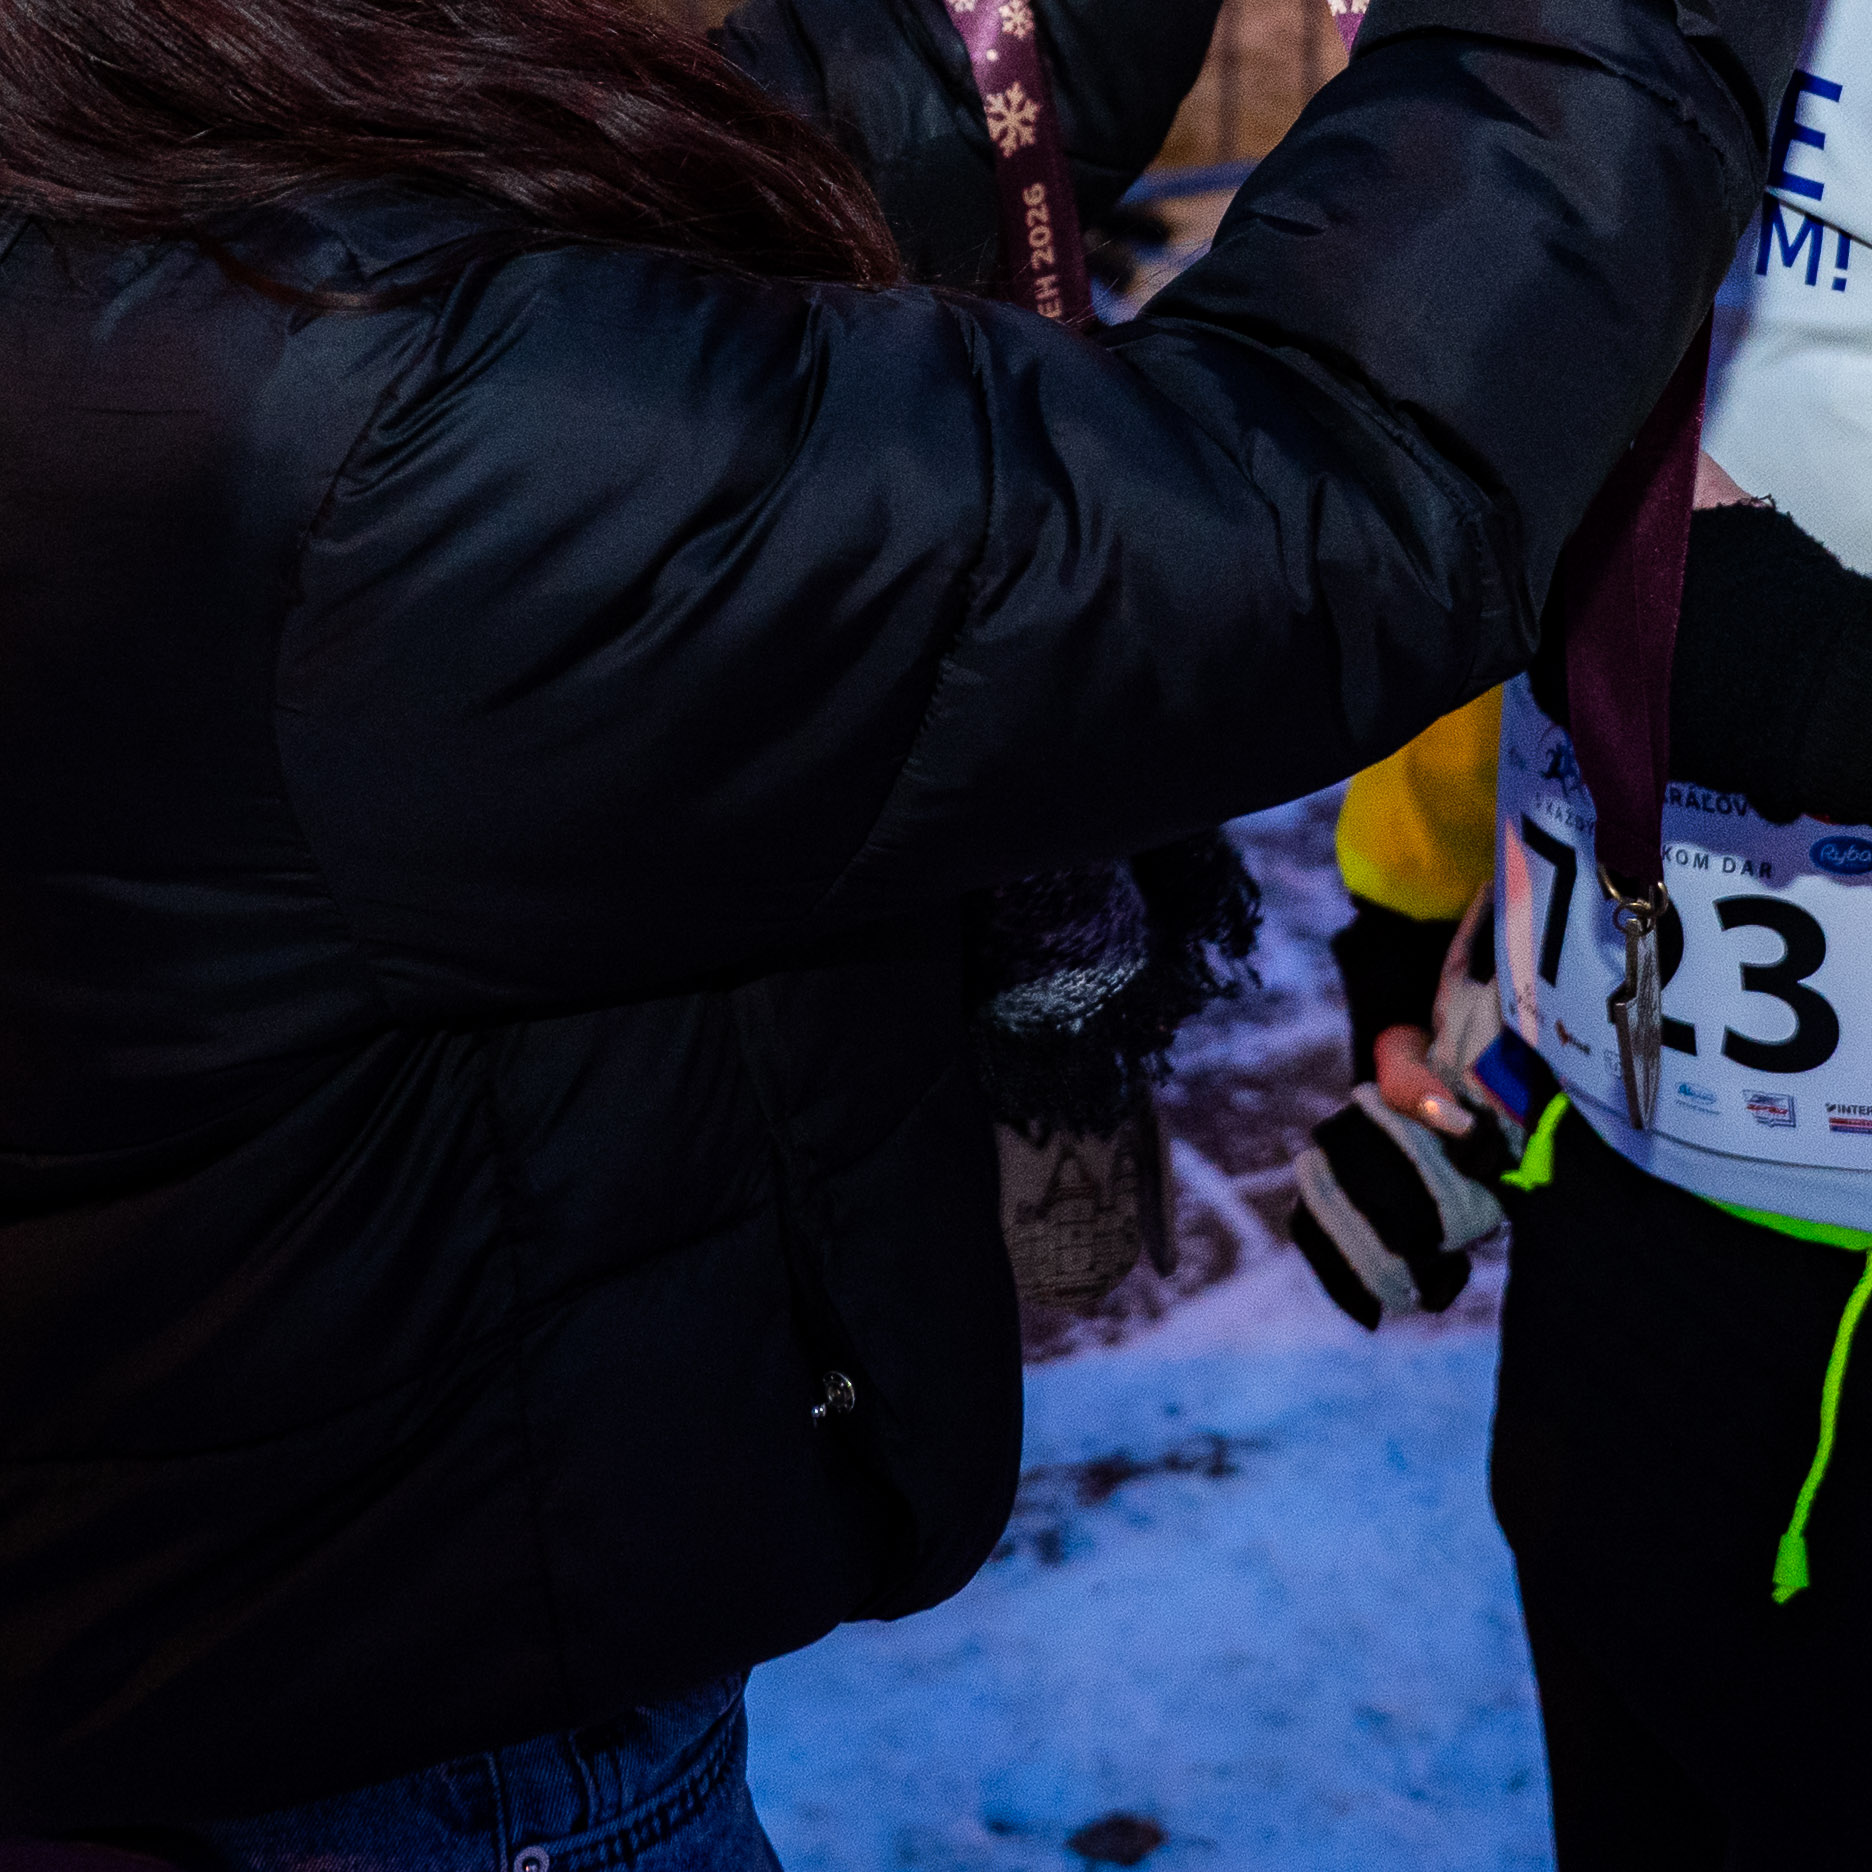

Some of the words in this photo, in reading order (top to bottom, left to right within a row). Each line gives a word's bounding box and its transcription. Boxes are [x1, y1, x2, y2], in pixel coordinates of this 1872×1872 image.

[1021, 181, 1056, 271] 2026
[1663, 783, 1749, 817] RÁĽOV
[1722, 856, 1773, 879] DAR
[1820, 842, 1872, 865] Ryba
